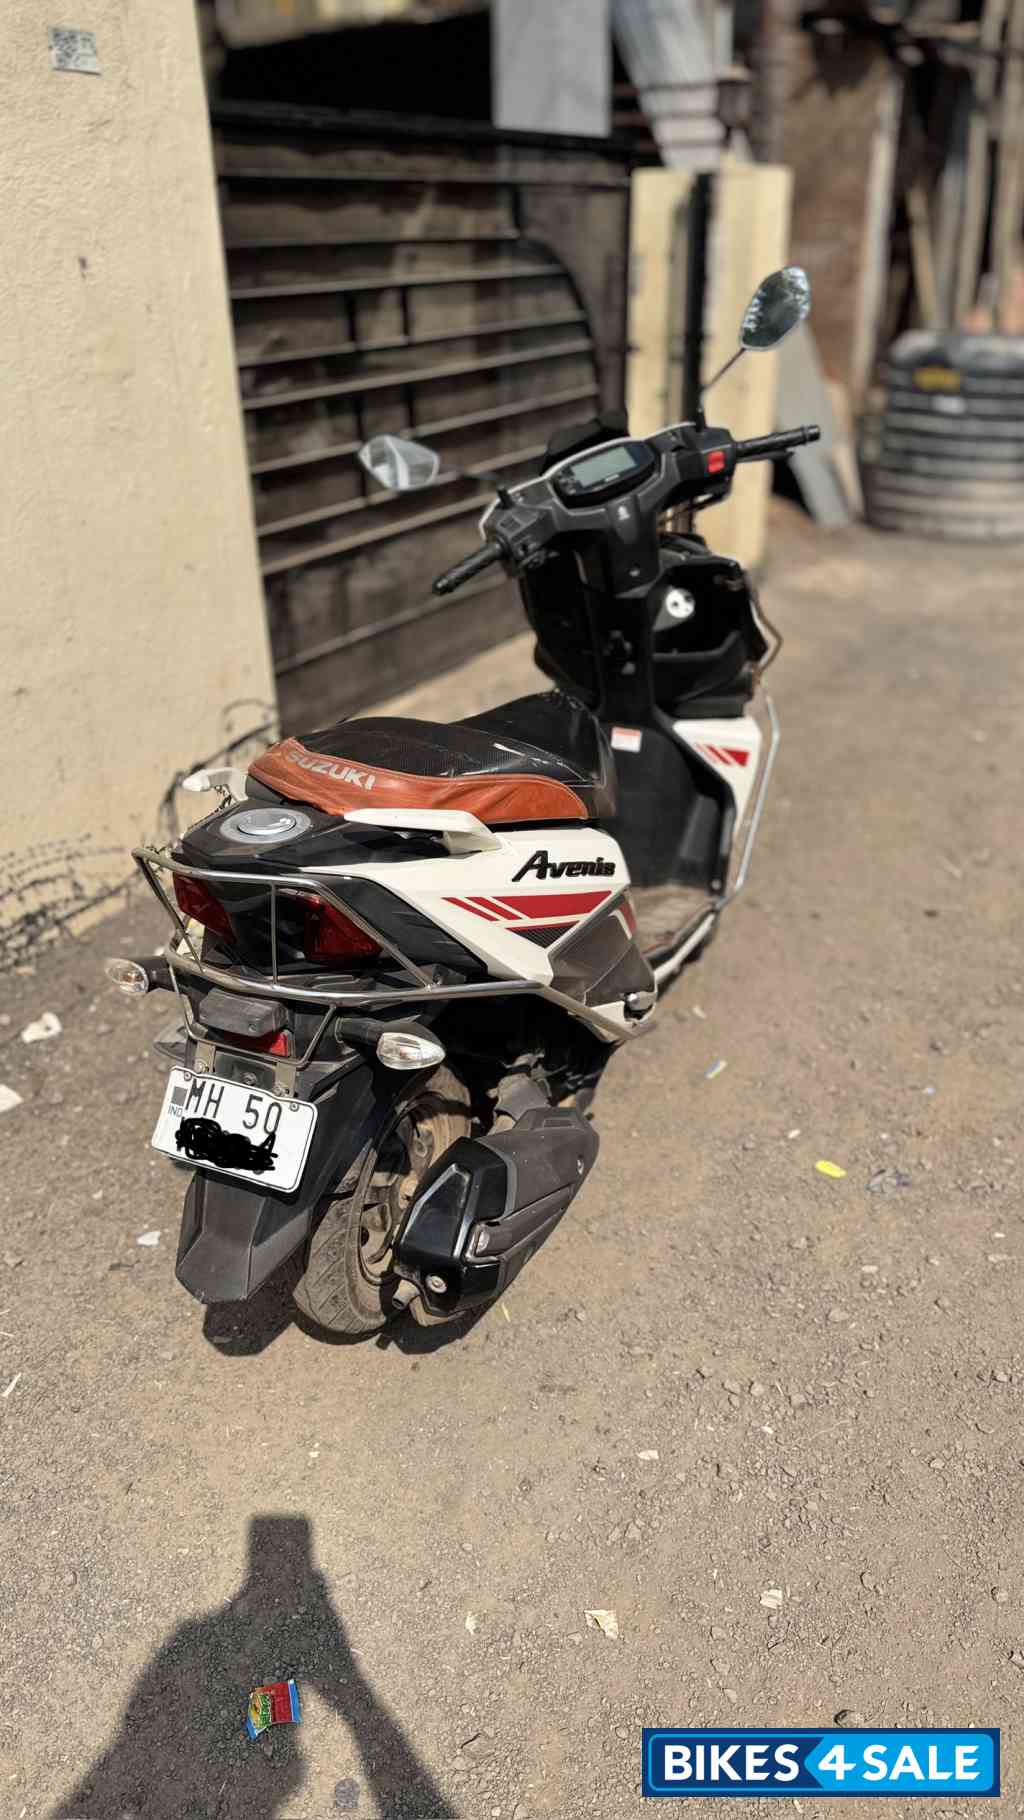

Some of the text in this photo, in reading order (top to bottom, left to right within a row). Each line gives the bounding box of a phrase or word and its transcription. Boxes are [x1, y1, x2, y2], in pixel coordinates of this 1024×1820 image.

[286, 752, 376, 791] SUZUKI
[511, 850, 616, 882] Avenis
[168, 1105, 183, 1117] IND
[184, 1078, 282, 1134] MH 50
